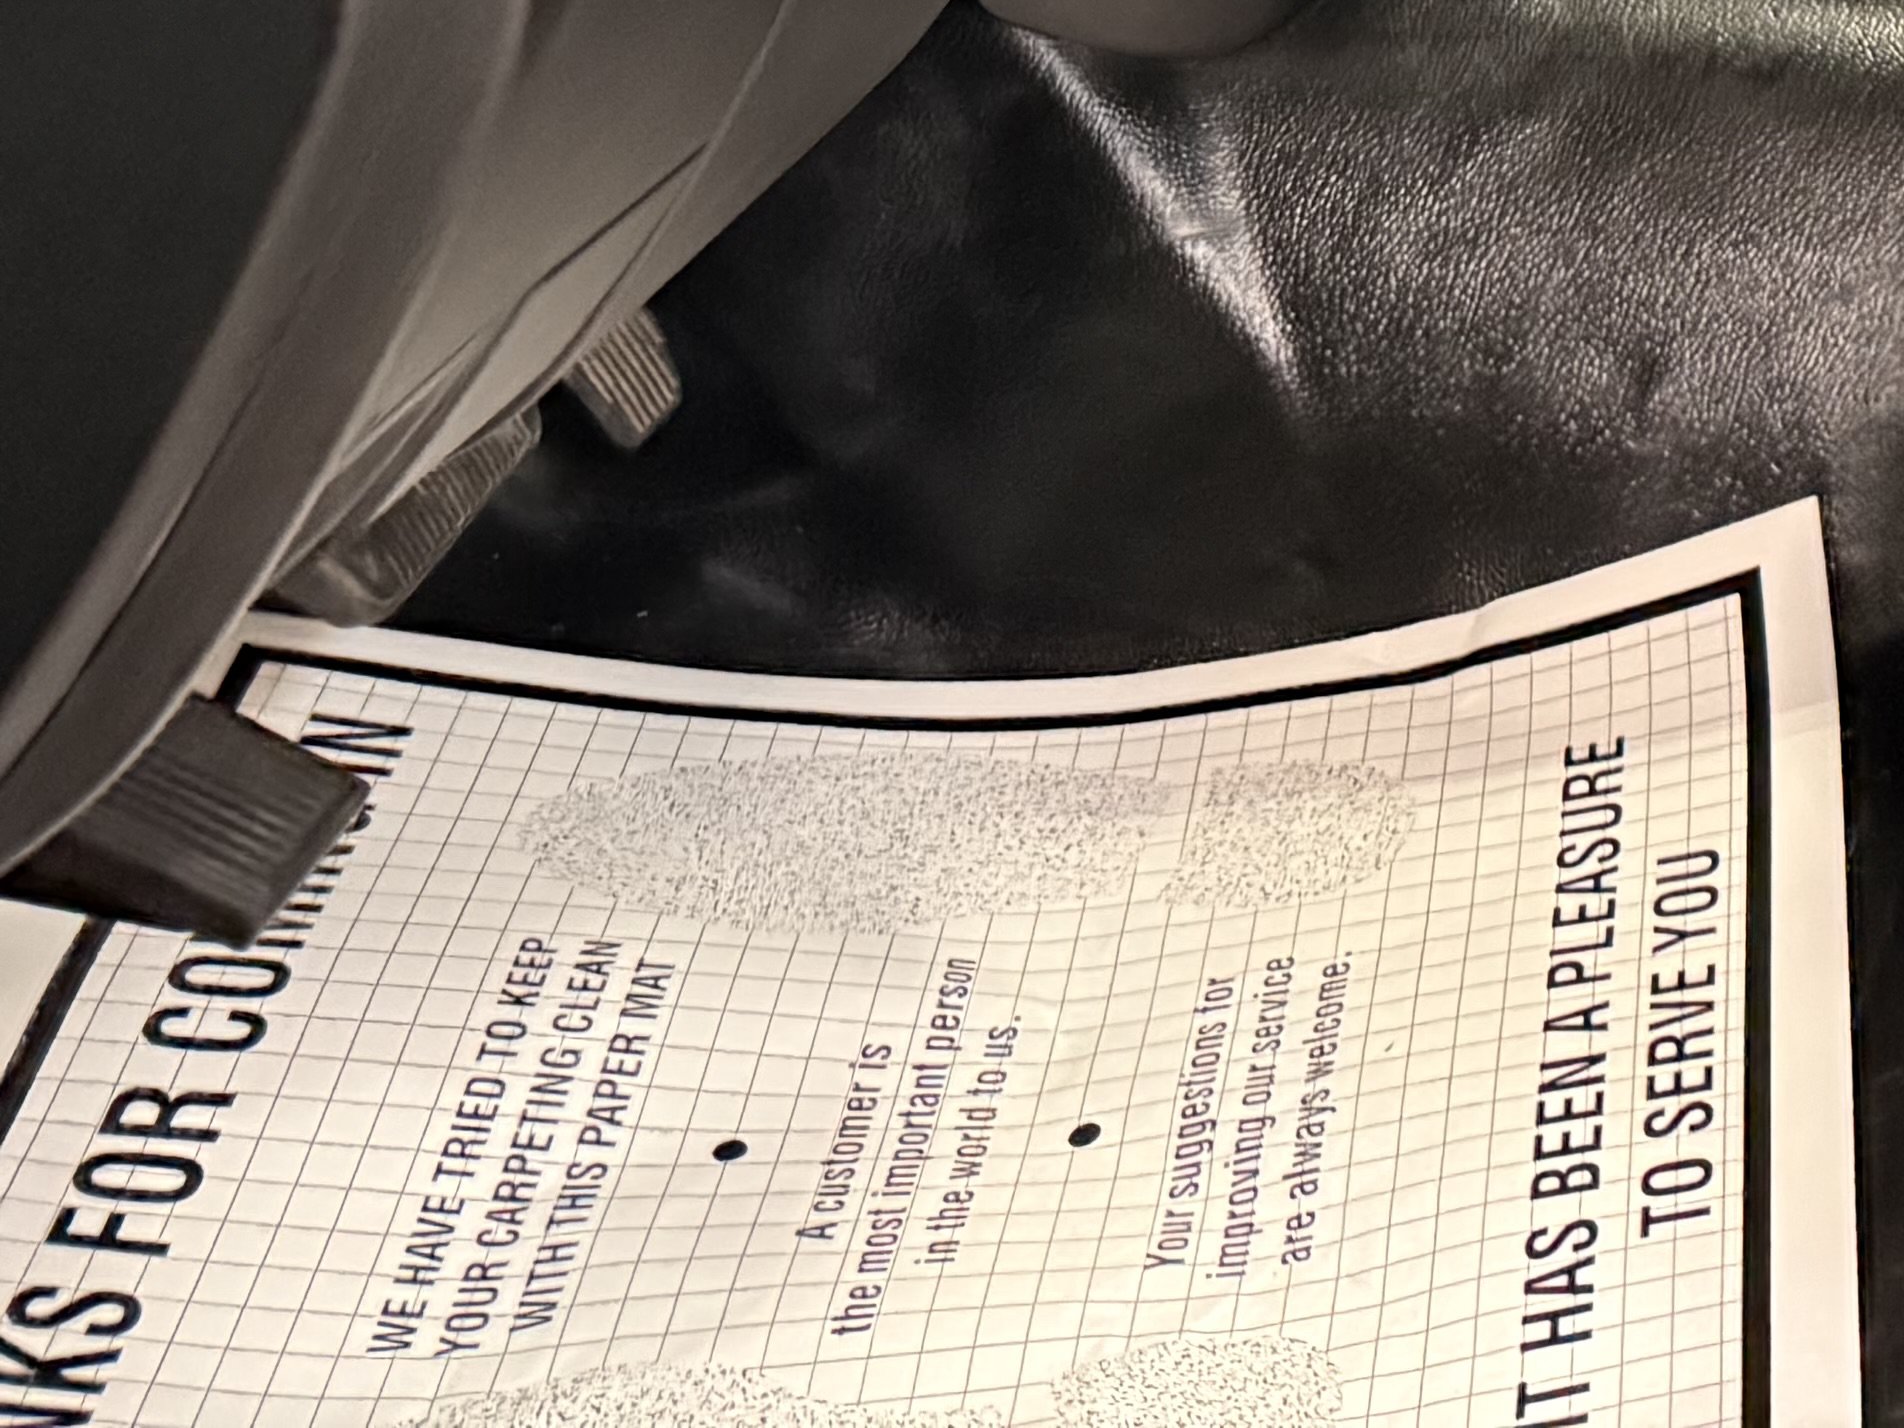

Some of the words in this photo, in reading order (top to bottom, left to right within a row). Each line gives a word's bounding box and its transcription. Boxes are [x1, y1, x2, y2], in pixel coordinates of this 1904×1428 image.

[1547, 735, 1626, 990] PLEASURE
[1652, 848, 1721, 957] YOU
[497, 937, 558, 1007] KEEP
[926, 958, 976, 1052] person
[1193, 976, 1235, 1014] for
[1252, 955, 1295, 1055] service
[476, 1021, 528, 1061] TO
[849, 1042, 893, 1070] is
[983, 1015, 1022, 1059] us.
[1302, 951, 1353, 1084] welcome.
[1543, 1000, 1610, 1033] A
[1643, 962, 1716, 1139] SERVE
[967, 1069, 1007, 1097] to
[1168, 1022, 1228, 1199] suggestions
[1242, 1063, 1276, 1107] our
[433, 1076, 506, 1182] TRIED
[434, 1260, 510, 1358] YOUR
[476, 1046, 583, 1248] CARPETING
[552, 939, 623, 1033] CLEAN
[509, 1241, 580, 1332] WITH
[547, 1162, 609, 1233] THIS
[578, 1032, 652, 1147] PAPER
[620, 957, 676, 1020] MAT
[813, 1082, 882, 1214] customer
[871, 1062, 950, 1198] important
[950, 1107, 997, 1181] world
[1282, 1087, 1336, 1200] always
[1530, 1052, 1607, 1201] BEEN
[45, 1086, 238, 1257] FOR
[926, 1190, 974, 1232] the
[1206, 1115, 1276, 1280] improving
[1640, 1157, 1714, 1239] TO
[394, 1194, 464, 1286] HAVE
[795, 1222, 838, 1240] A
[857, 1206, 907, 1273] most
[914, 1239, 960, 1265] in
[1143, 1209, 1195, 1271] Your
[1281, 1210, 1315, 1265] are
[367, 1298, 428, 1353] WE
[831, 1284, 882, 1336] the
[1520, 1218, 1599, 1354] HAS
[1515, 1381, 1591, 1428] IT
